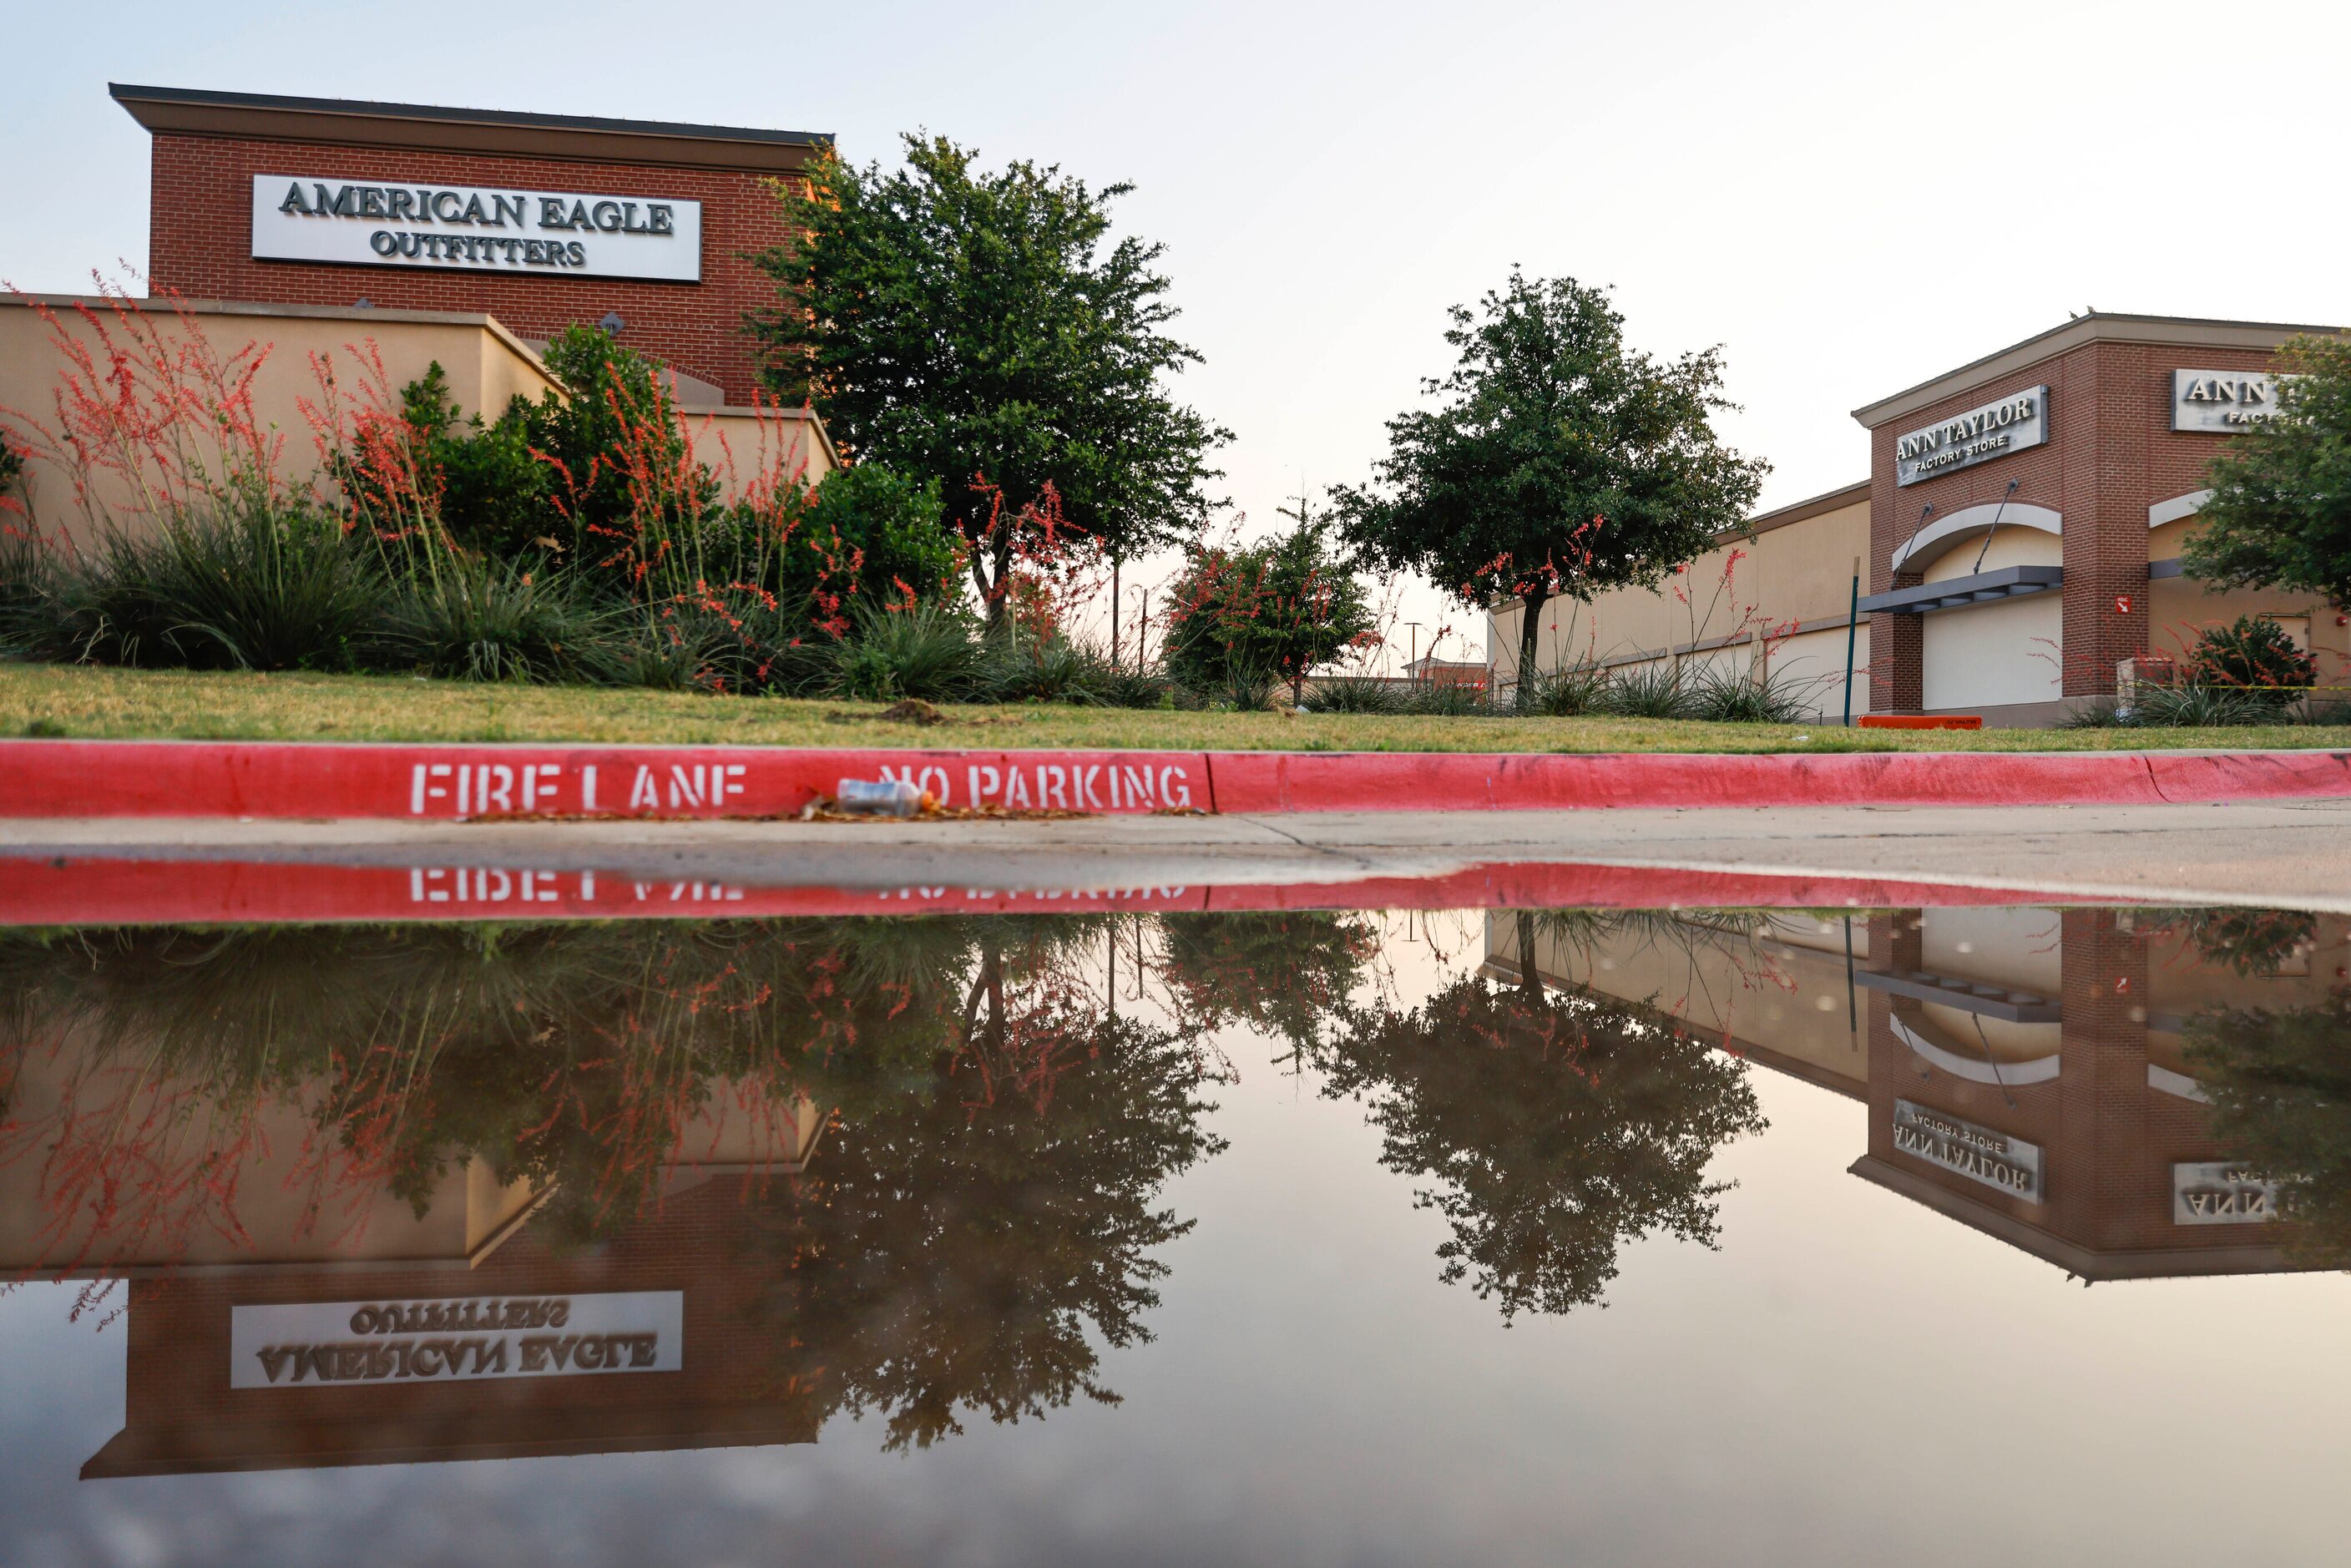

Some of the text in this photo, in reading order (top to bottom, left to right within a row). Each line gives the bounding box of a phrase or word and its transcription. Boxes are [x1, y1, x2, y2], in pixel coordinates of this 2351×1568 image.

[278, 181, 674, 235] AMERICAN EAGLE
[370, 230, 586, 266] OUTFITTERS
[2187, 377, 2268, 403] ANN
[1895, 397, 2032, 462] ANN TAYLOR
[1914, 435, 2006, 473] FACTORY STORE
[967, 764, 1192, 808] PARKING
